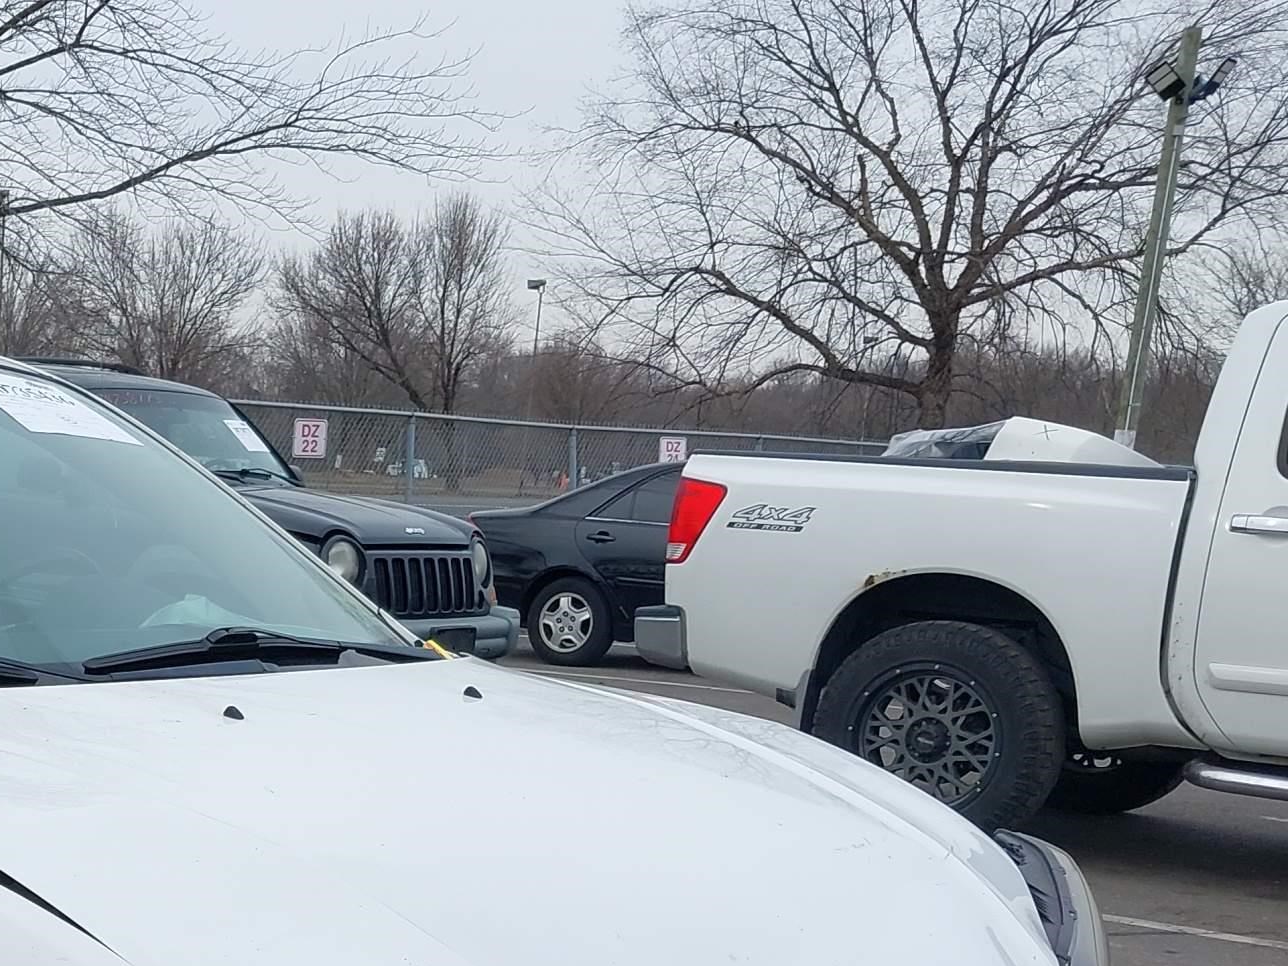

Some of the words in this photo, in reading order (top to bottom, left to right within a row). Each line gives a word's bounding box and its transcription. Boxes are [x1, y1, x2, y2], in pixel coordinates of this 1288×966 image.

[302, 424, 321, 438] DZ
[302, 440, 318, 453] 22
[666, 441, 681, 453] DZ
[733, 522, 759, 530] OFF
[761, 524, 796, 532] ROAD
